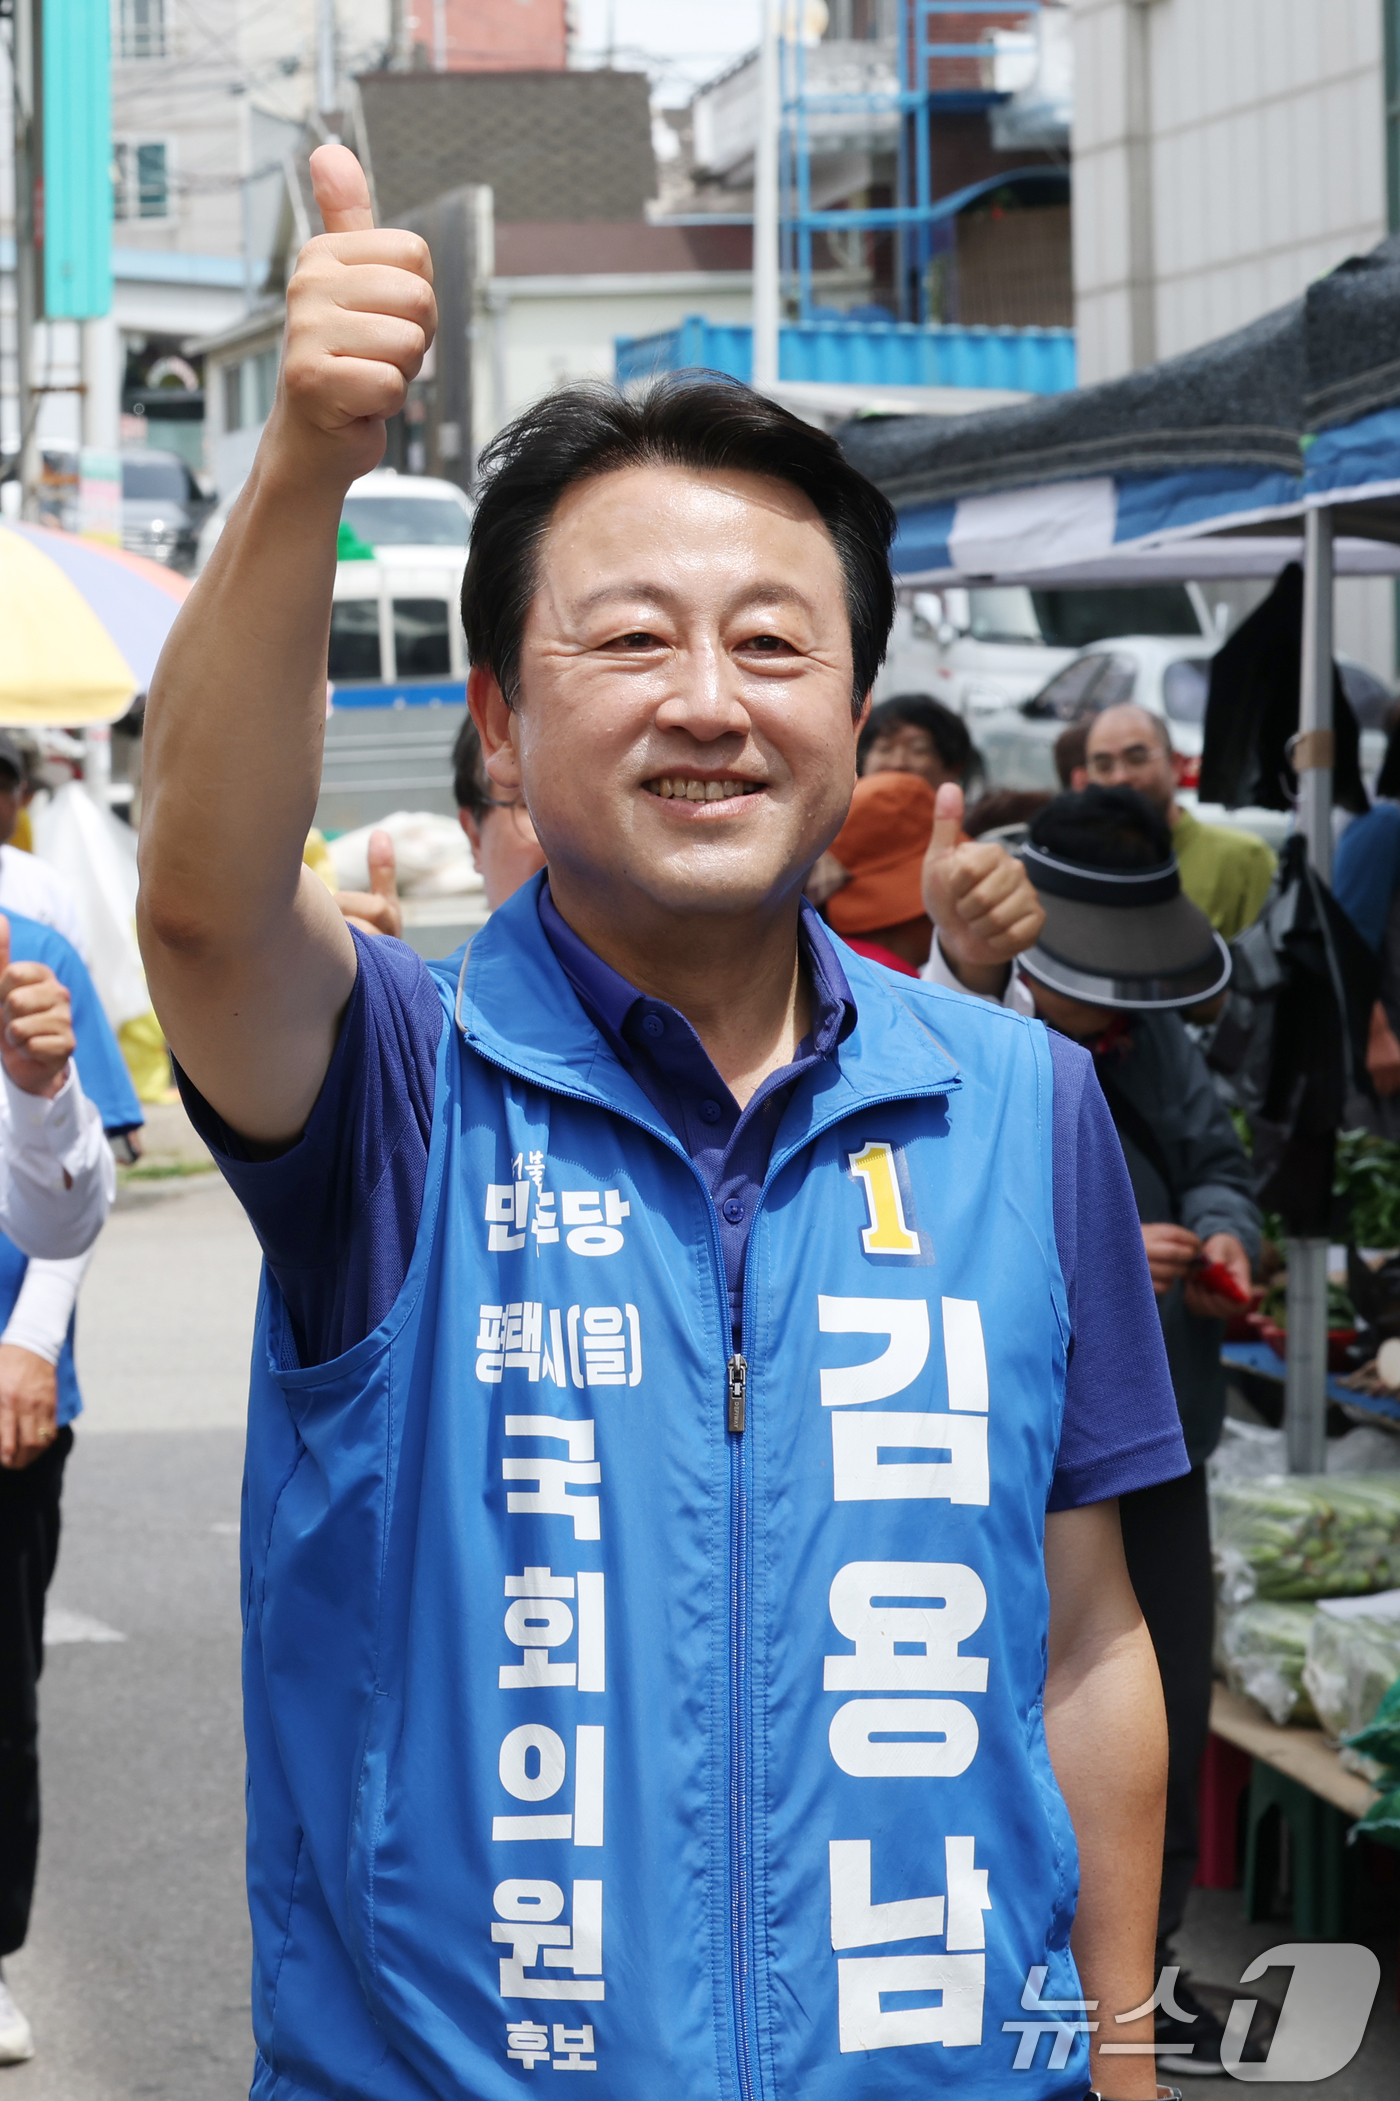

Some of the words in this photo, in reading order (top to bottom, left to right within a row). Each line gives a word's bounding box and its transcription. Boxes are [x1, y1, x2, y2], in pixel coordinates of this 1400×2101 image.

[848, 1141, 923, 1256] 1
[490, 1414, 606, 2002] 국회의원
[817, 1294, 993, 2054] 김용남
[506, 2020, 598, 2071] 후보
